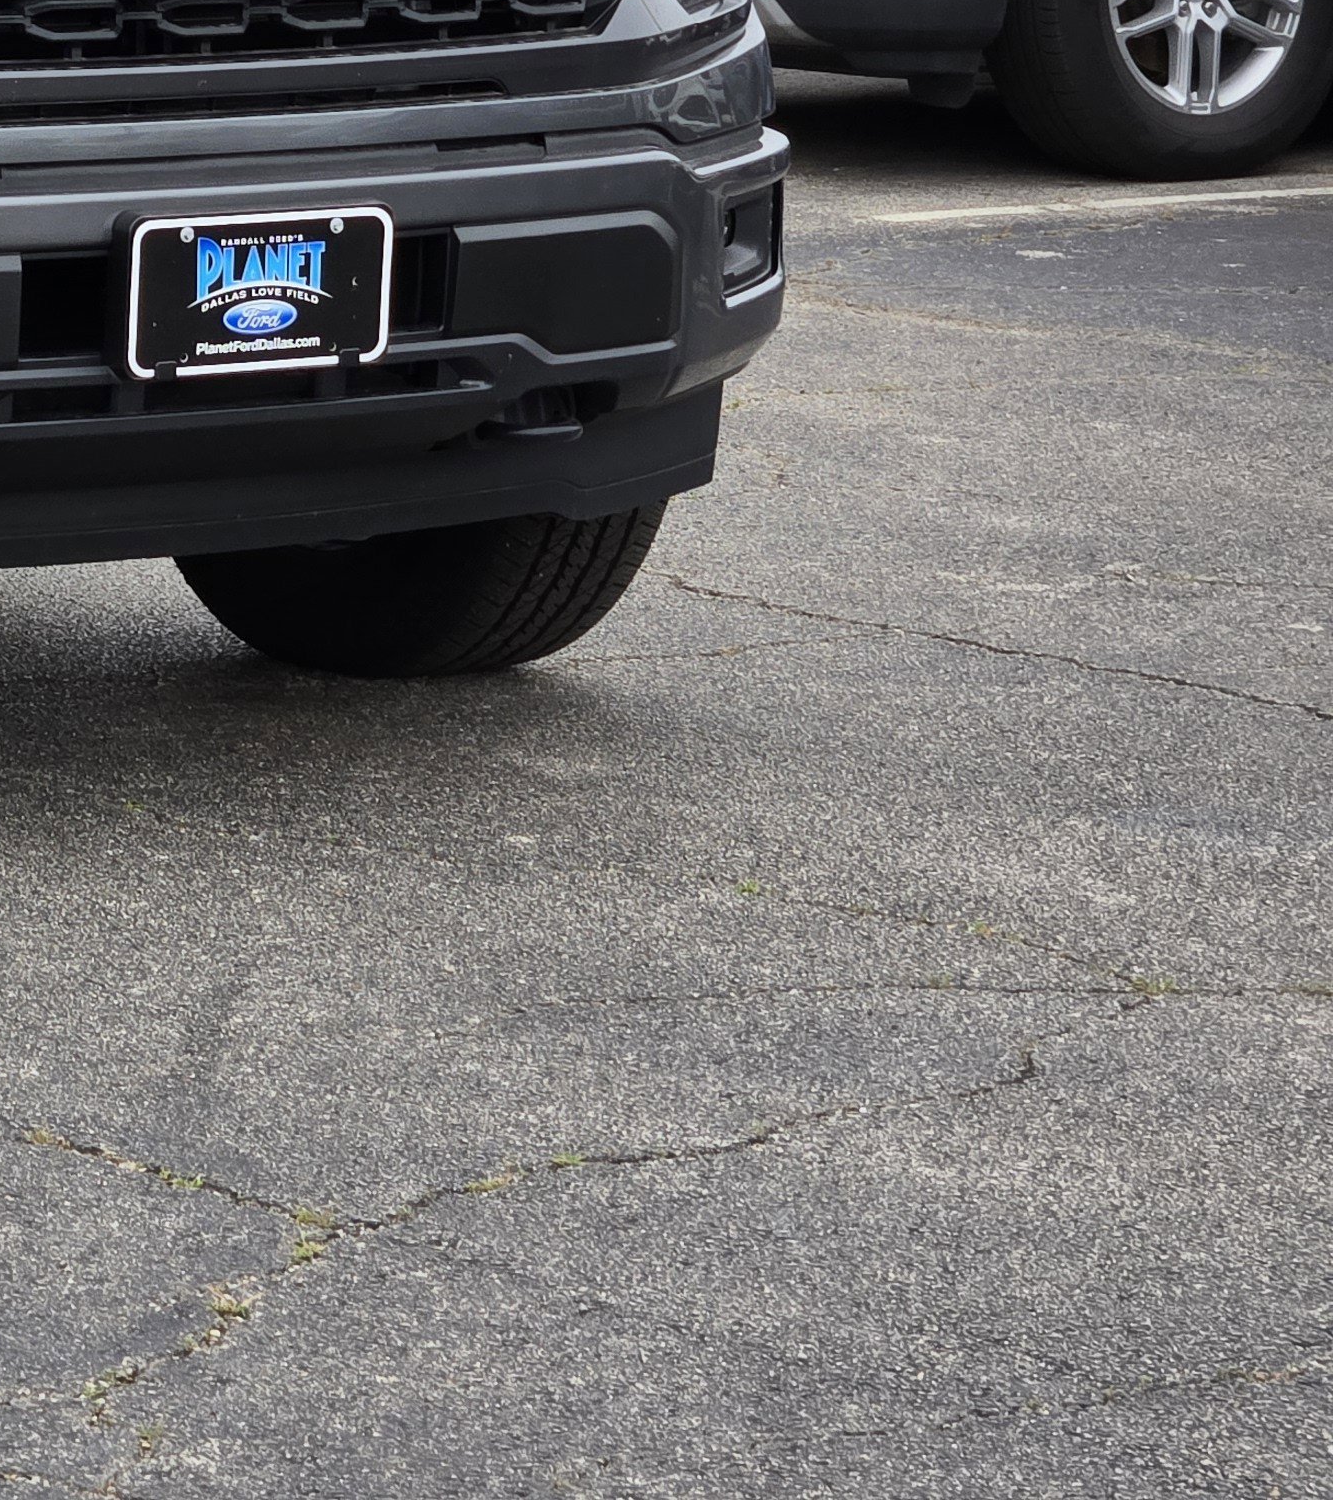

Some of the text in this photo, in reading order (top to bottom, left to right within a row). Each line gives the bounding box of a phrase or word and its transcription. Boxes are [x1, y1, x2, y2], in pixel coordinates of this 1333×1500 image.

[197, 236, 326, 302] PLANET
[201, 288, 319, 312] DALLAS LOVE FIELD
[237, 304, 283, 328] Ford
[196, 336, 320, 355] PlanetFordDallas.com
